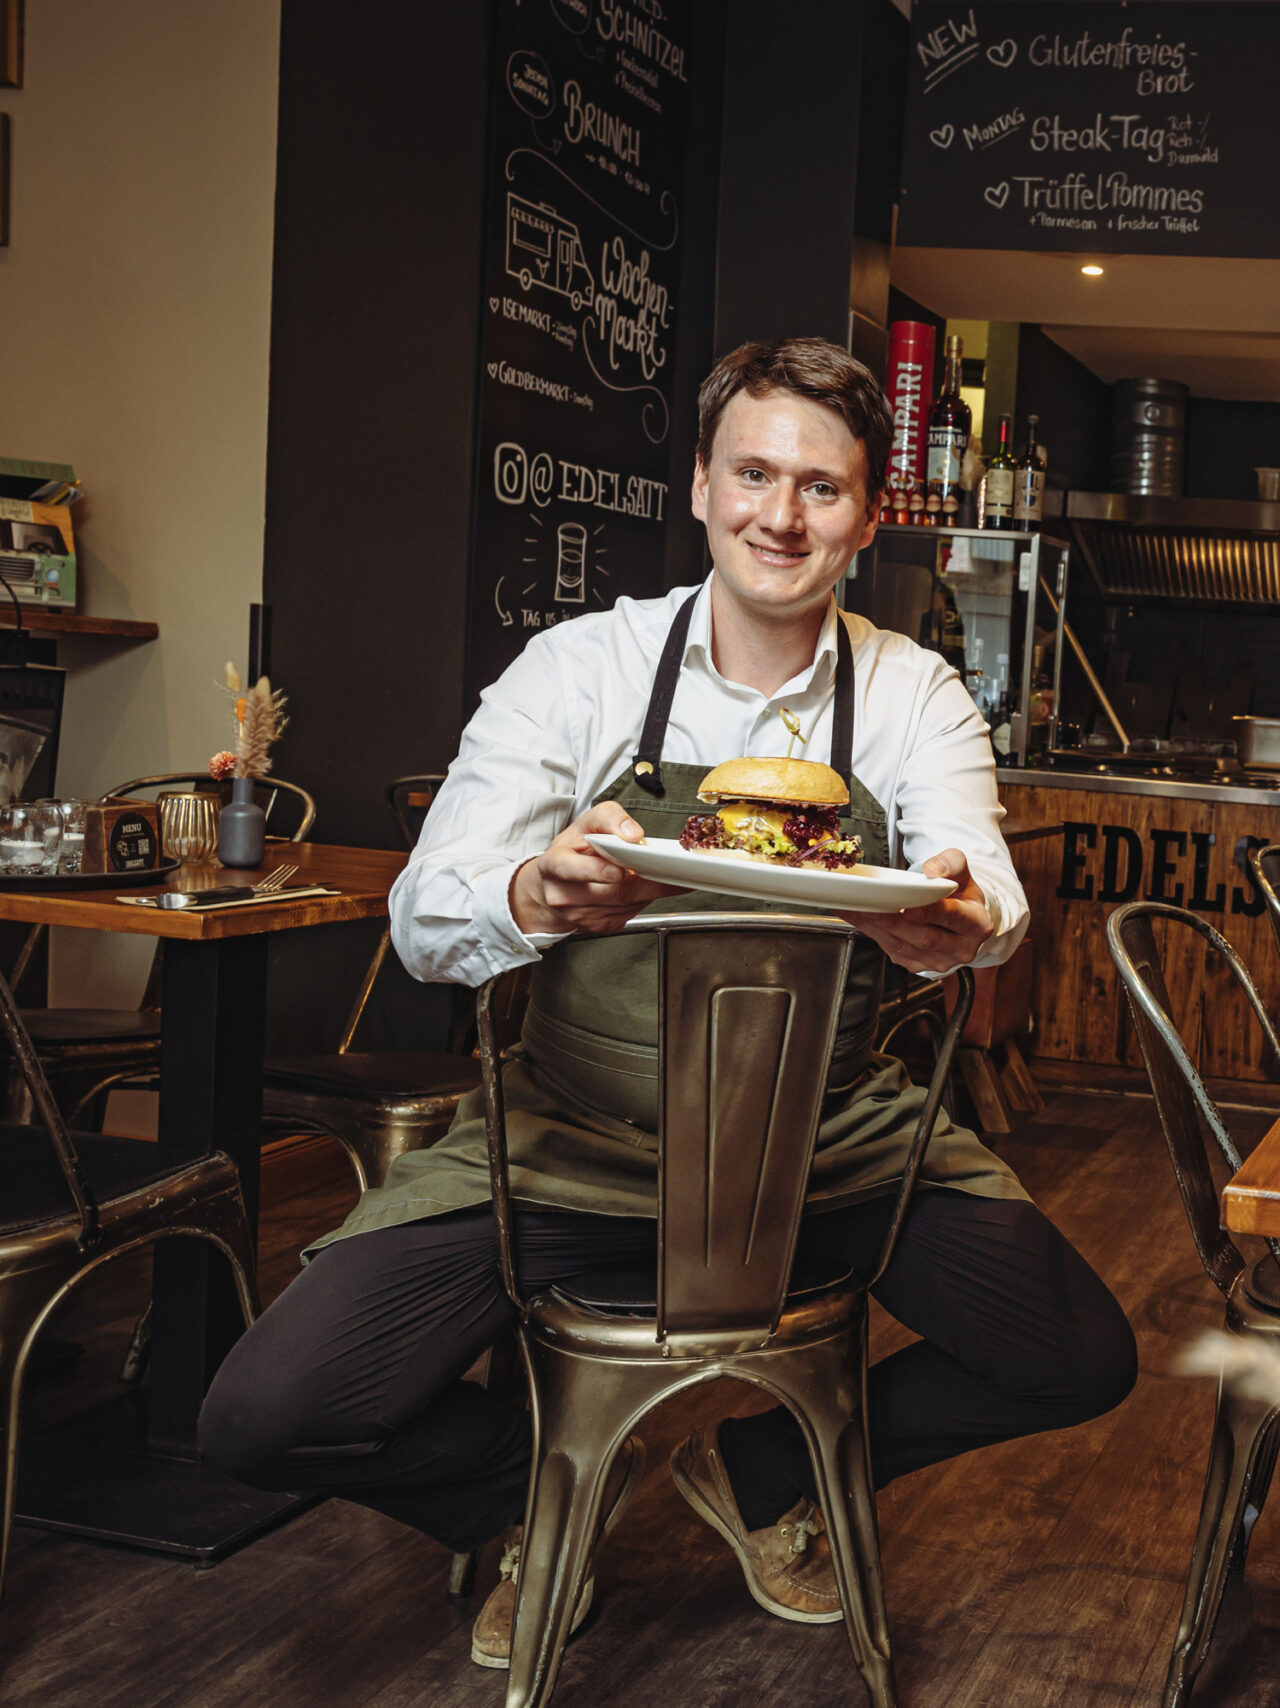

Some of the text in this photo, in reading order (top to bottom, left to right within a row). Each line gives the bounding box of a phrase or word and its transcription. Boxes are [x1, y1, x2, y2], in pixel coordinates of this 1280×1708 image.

[917, 8, 978, 67] NEW
[1136, 67, 1195, 96] Brot
[563, 80, 640, 167] BRUNCH
[1030, 113, 1165, 162] Steak-Tag
[502, 296, 553, 333] ISEMARKT
[890, 361, 922, 490] CAMPARI
[927, 431, 967, 447] AMPARI
[122, 823, 142, 834] MENU
